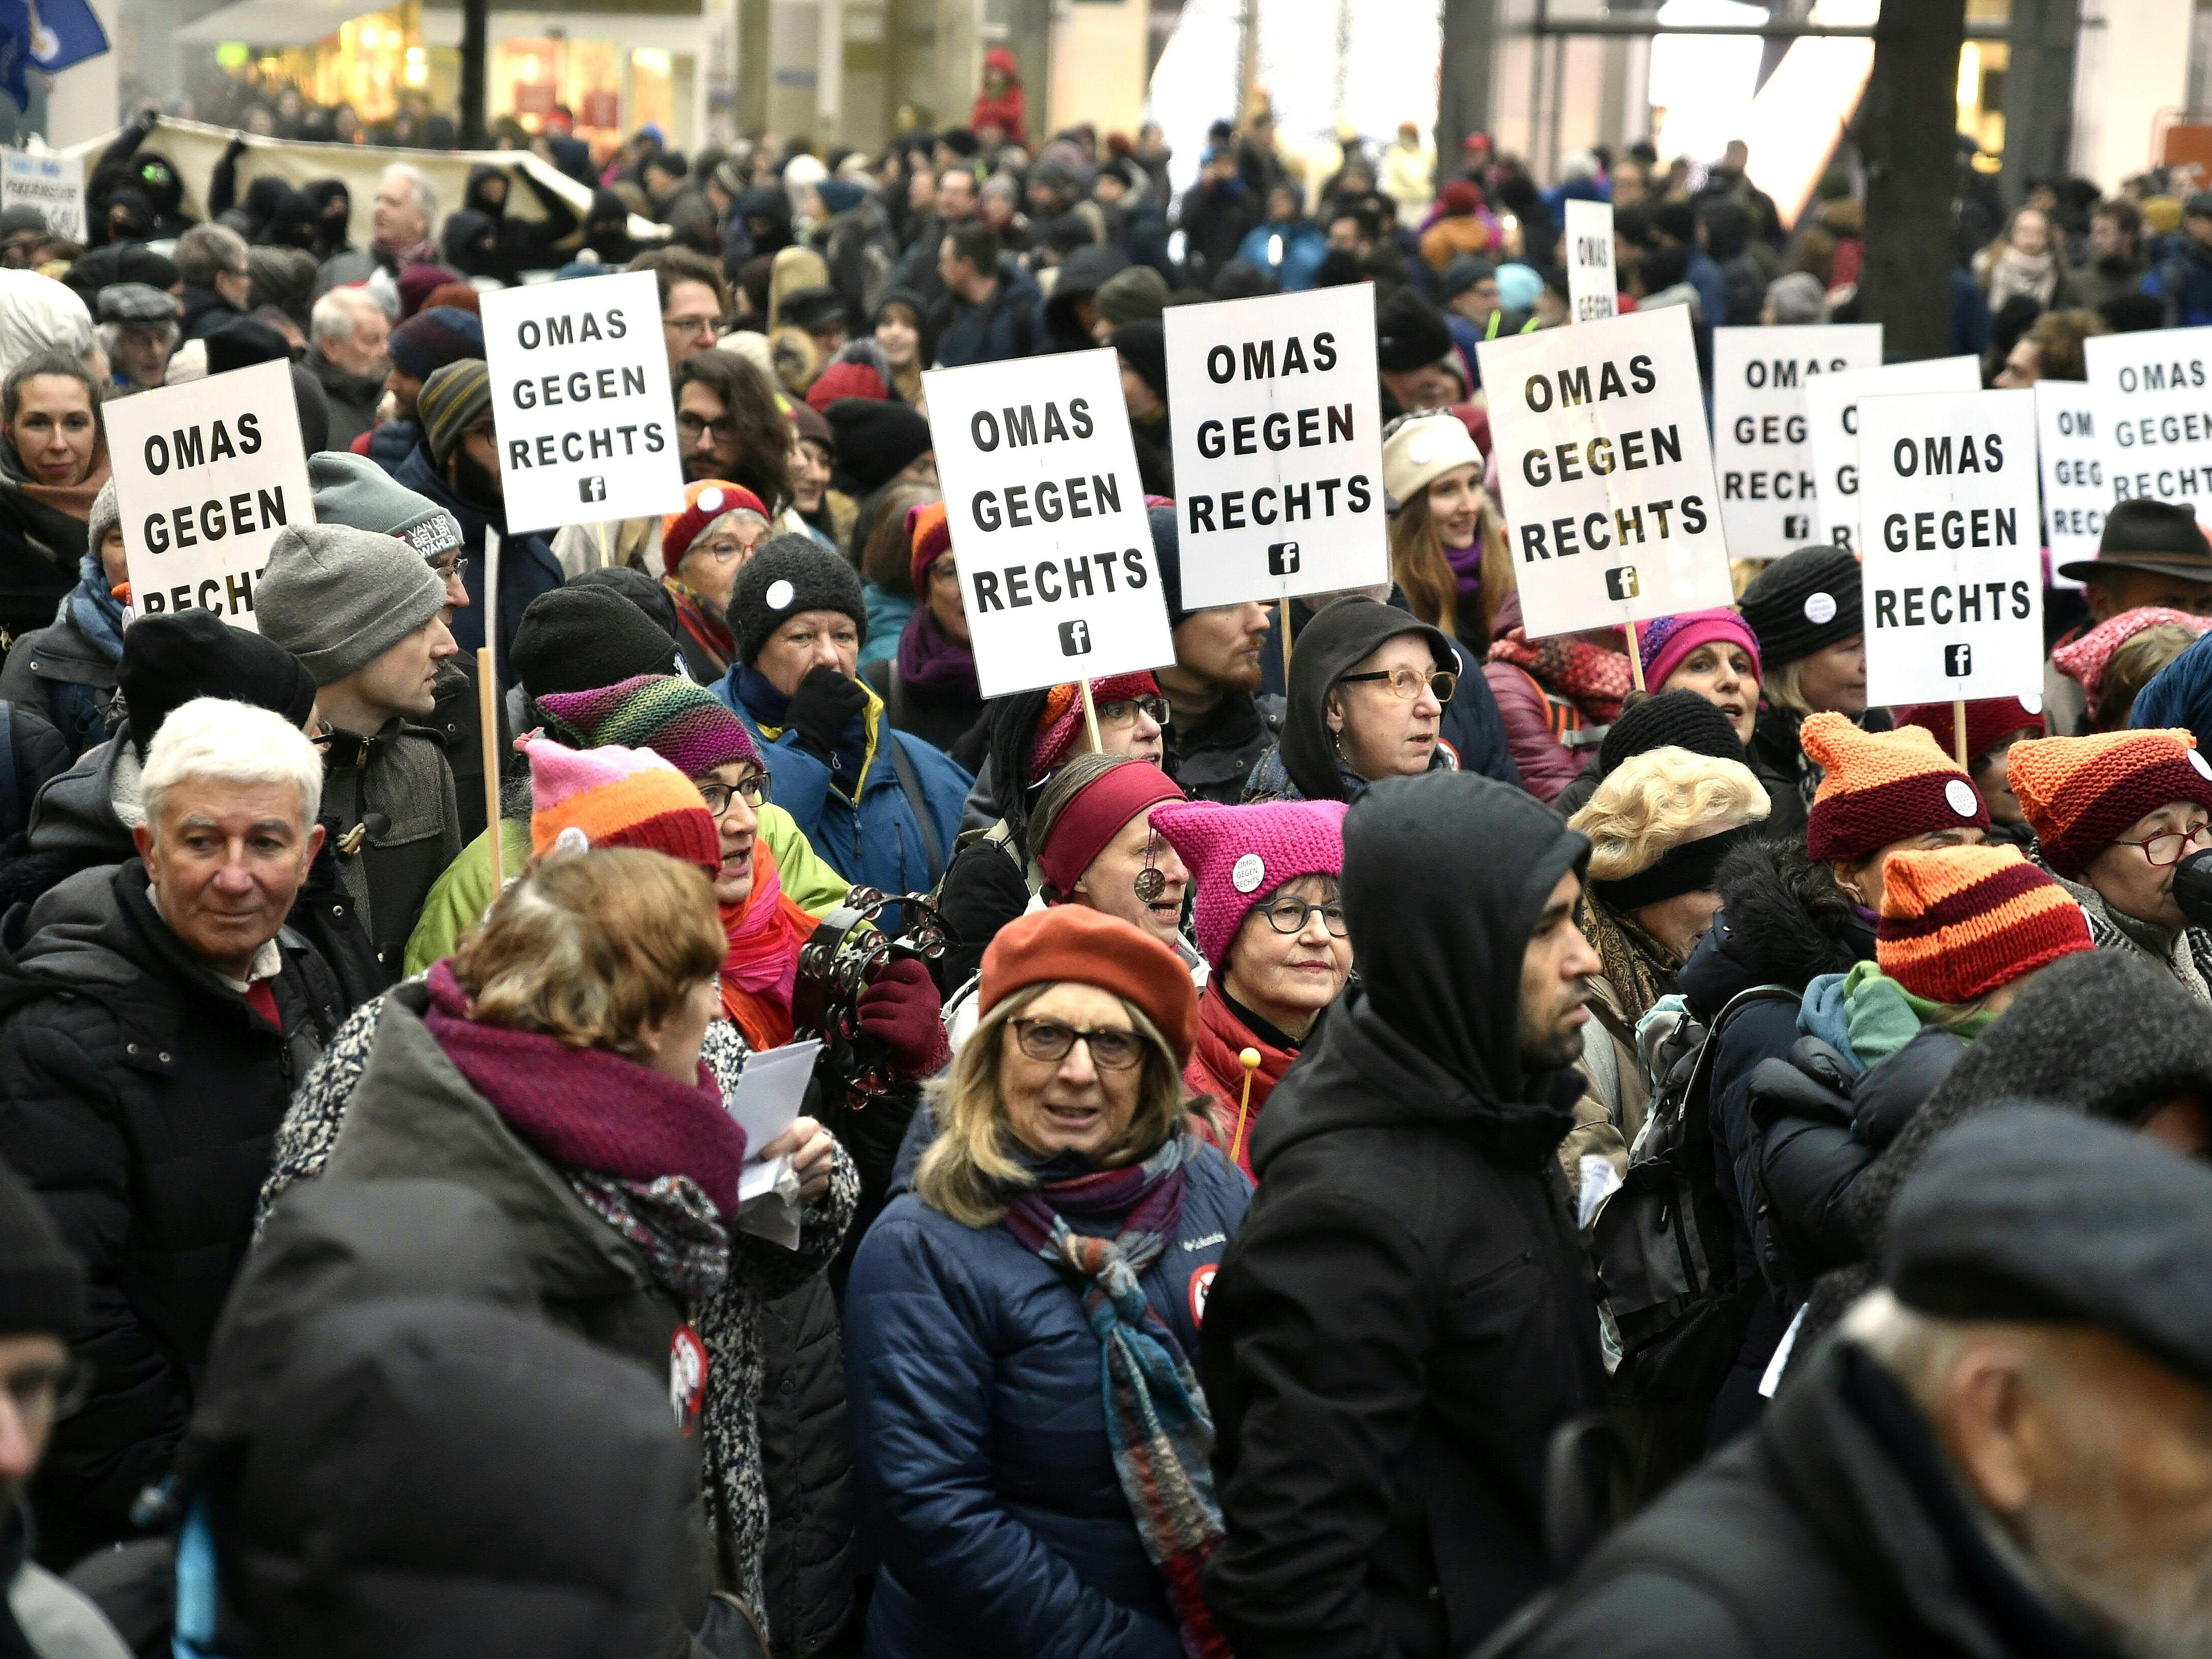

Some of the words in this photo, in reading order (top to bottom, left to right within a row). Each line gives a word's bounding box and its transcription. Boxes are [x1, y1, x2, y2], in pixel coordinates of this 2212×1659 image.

[517, 310, 627, 350] OMAS
[1206, 331, 1337, 385] OMAS
[2118, 359, 2206, 394] OMAS
[512, 365, 646, 410] GEGEN
[1525, 354, 1656, 413] OMAS
[144, 412, 262, 476] OMAS
[970, 398, 1094, 453] OMAS
[1196, 403, 1354, 460] GEGEN
[1733, 414, 1808, 446] GEG
[2058, 411, 2093, 436] OM
[508, 423, 665, 470] RECHTS
[1522, 424, 1682, 488] GEGEN
[1893, 433, 2004, 477] OMAS
[1723, 469, 1816, 502] RECH
[2056, 460, 2103, 486] GEG
[2113, 465, 2212, 501] RECHT
[143, 485, 288, 555] GEGEN
[971, 472, 1122, 533] GEGEN
[1188, 474, 1371, 535] RECHTS
[2053, 509, 2104, 535] REC
[407, 521, 432, 538] VAN
[411, 526, 451, 548] BELLEN
[1520, 495, 1708, 563] RECHTS
[1883, 507, 2017, 553] GEGEN
[142, 567, 265, 618] RECH
[972, 548, 1148, 614] RECHTS
[1875, 580, 2031, 629] RECHTS
[1236, 867, 1259, 879] GEGEN
[1236, 876, 1261, 889] RECHTS
[1237, 858, 1257, 869] OMAS
